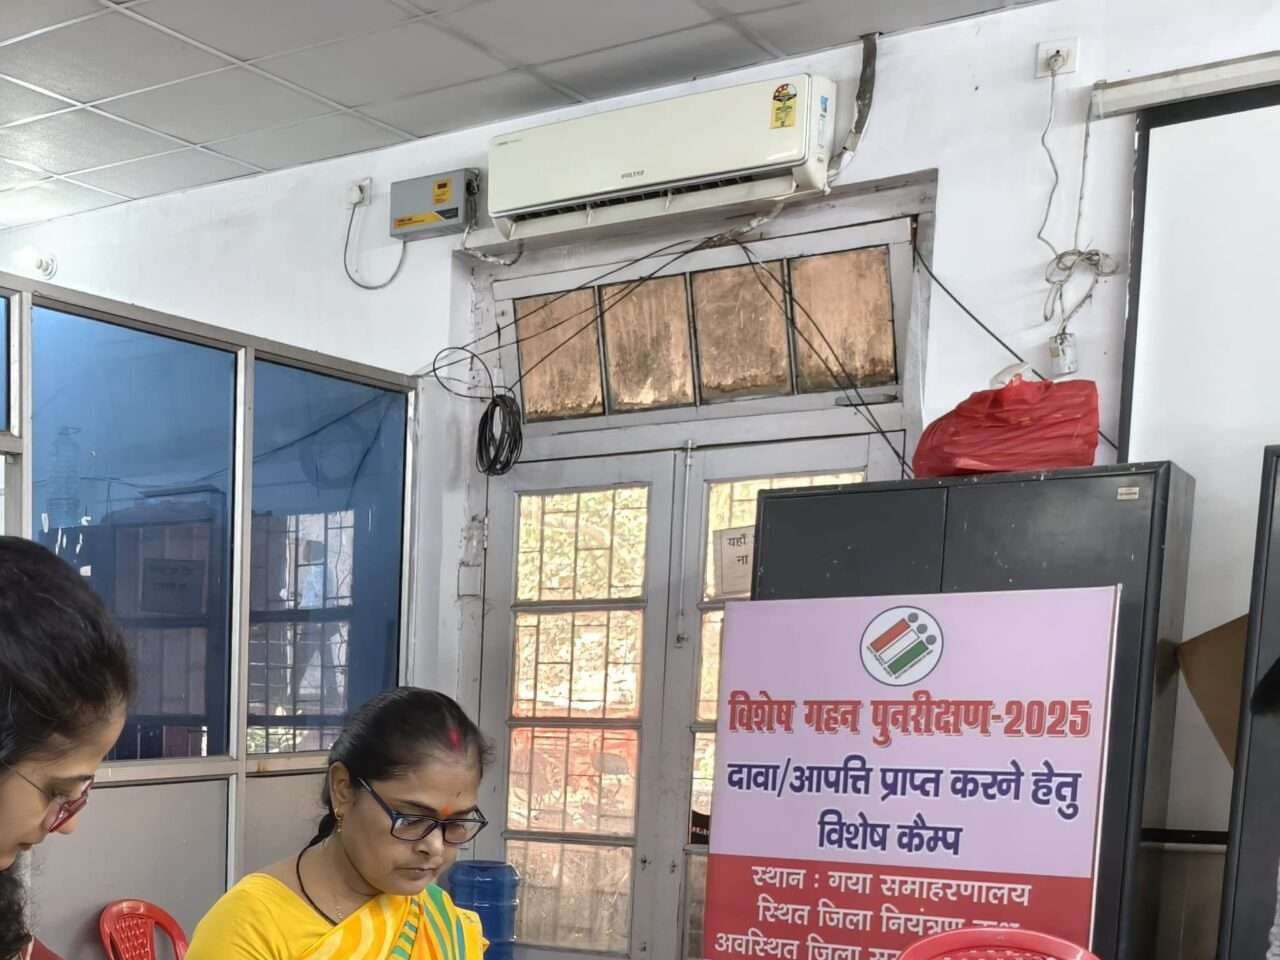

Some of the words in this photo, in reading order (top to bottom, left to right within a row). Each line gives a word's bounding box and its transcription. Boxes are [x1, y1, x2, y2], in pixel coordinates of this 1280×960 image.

[728, 690, 795, 735] विशेष
[804, 698, 863, 735] गहन
[871, 689, 1091, 747] पुनरीक्षण-2025
[727, 754, 873, 797] दावा/आपत्ति
[881, 767, 942, 801] प्राप्त
[950, 760, 1024, 801] करने
[1032, 761, 1082, 820] हेतु
[818, 809, 890, 852] विशेष
[897, 812, 963, 856] कैम्प
[751, 865, 807, 889] स्थान
[828, 871, 873, 895] गया
[880, 875, 1033, 906] समाहरणालय
[757, 894, 810, 926] स्थित
[817, 898, 873, 932] जिला
[881, 903, 966, 937] नियंत्रण
[714, 929, 799, 960] अवस्थित
